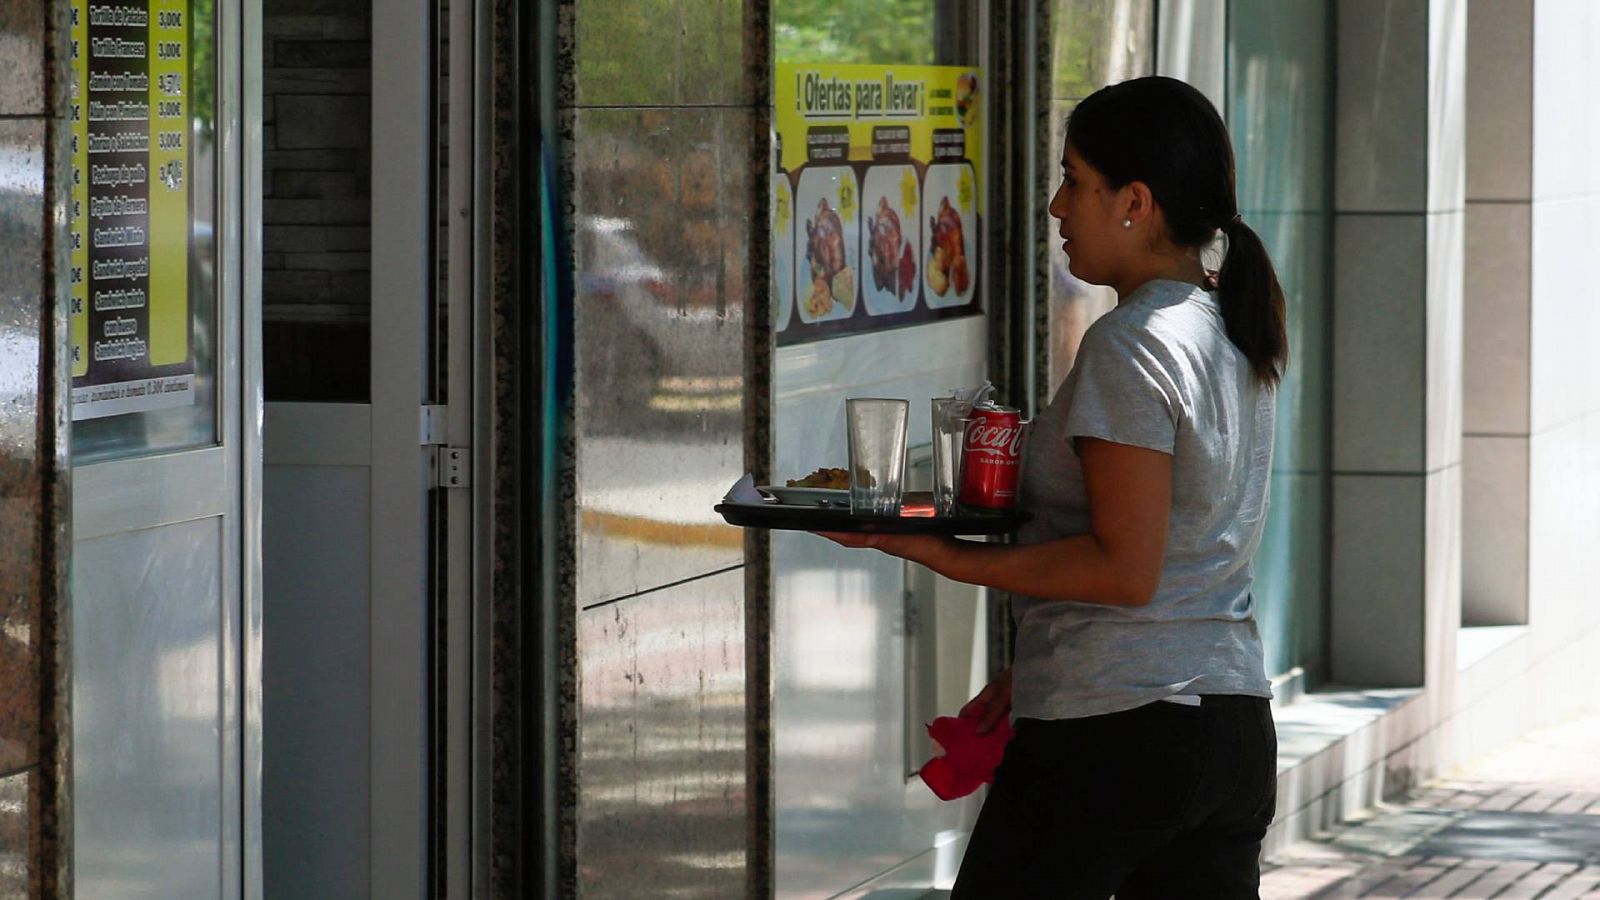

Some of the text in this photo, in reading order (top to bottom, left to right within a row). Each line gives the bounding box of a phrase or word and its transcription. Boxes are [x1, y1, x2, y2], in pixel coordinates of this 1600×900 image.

[90, 5, 113, 26] Tortilla
[114, 6, 122, 26] de
[122, 6, 148, 27] Patatas
[159, 11, 182, 28] 3,00€
[92, 37, 115, 58] Tortilla
[115, 37, 146, 59] Francesa
[158, 42, 181, 59] 3,00€
[112, 74, 124, 91] con
[124, 71, 148, 92] Tomate
[804, 72, 852, 112] Ofertas
[855, 81, 882, 120] para
[885, 73, 918, 112] llevar
[105, 104, 118, 121] con
[158, 100, 181, 118] 3,00€
[158, 132, 181, 151] 3,00€
[92, 164, 119, 187] Pechuga
[119, 163, 129, 183] de
[113, 195, 121, 216] de
[121, 195, 147, 215] Ternera
[94, 226, 125, 248] Sandwich
[93, 258, 124, 280] Sandwich
[95, 289, 126, 312] Sandwich
[104, 320, 118, 337] con
[95, 338, 126, 361] Sandwich
